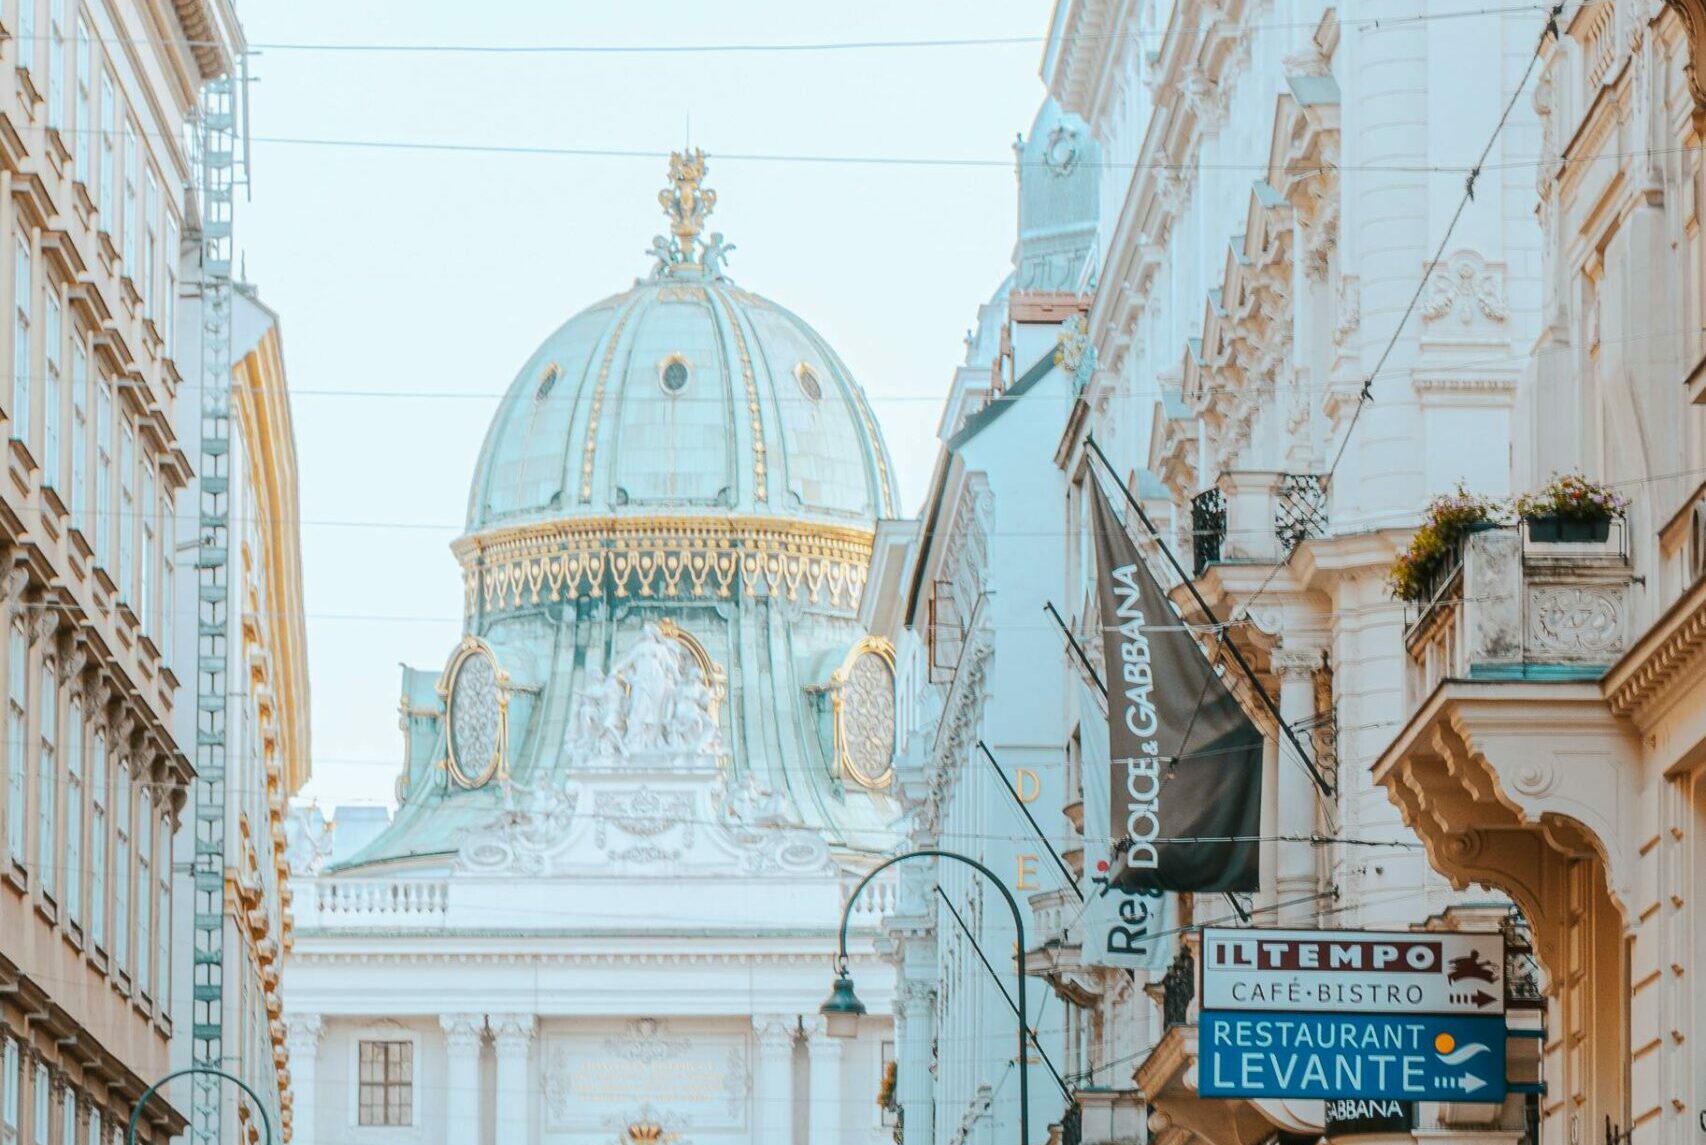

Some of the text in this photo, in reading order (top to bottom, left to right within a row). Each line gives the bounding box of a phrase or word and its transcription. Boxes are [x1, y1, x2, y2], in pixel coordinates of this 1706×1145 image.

[1216, 943, 1435, 970] IL TEMPO
[1213, 1020, 1426, 1050] RESTAURANT
[1213, 1051, 1427, 1093] LEVANTE
